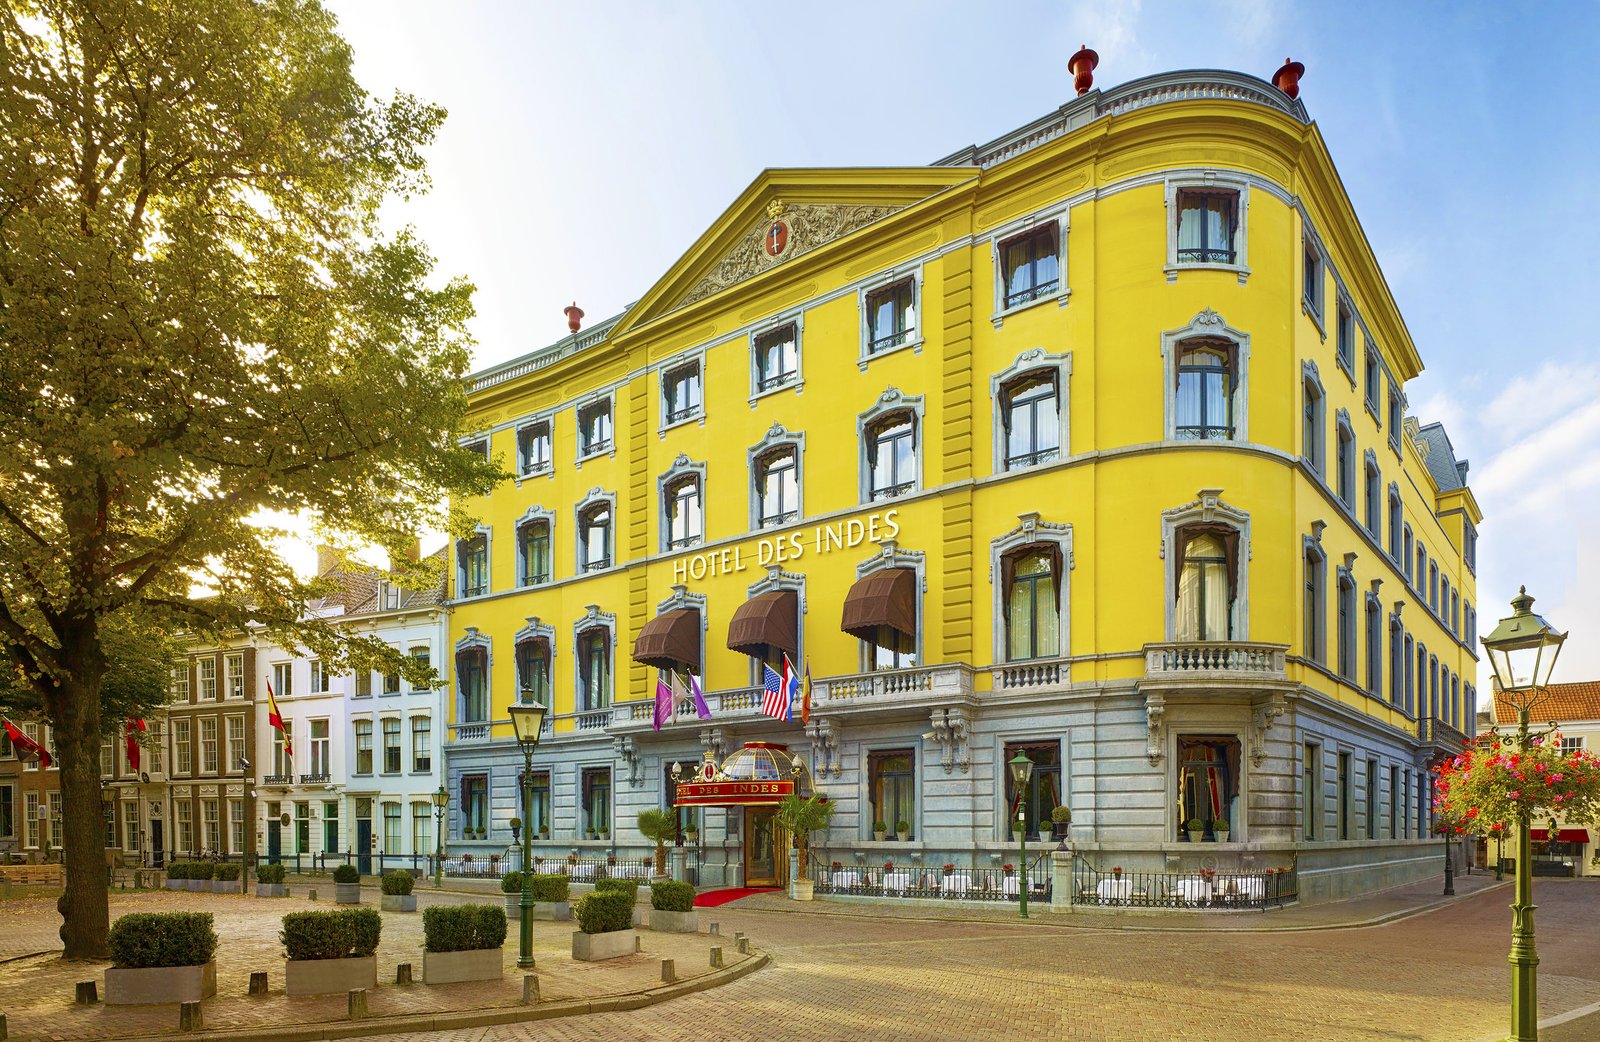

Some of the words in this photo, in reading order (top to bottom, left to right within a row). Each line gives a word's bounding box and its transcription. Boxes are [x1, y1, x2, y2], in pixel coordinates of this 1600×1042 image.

[673, 547, 746, 584] HOTEL
[758, 532, 803, 566] DES
[816, 510, 900, 553] INDES
[699, 786, 719, 794] DES
[733, 784, 779, 793] INDES
